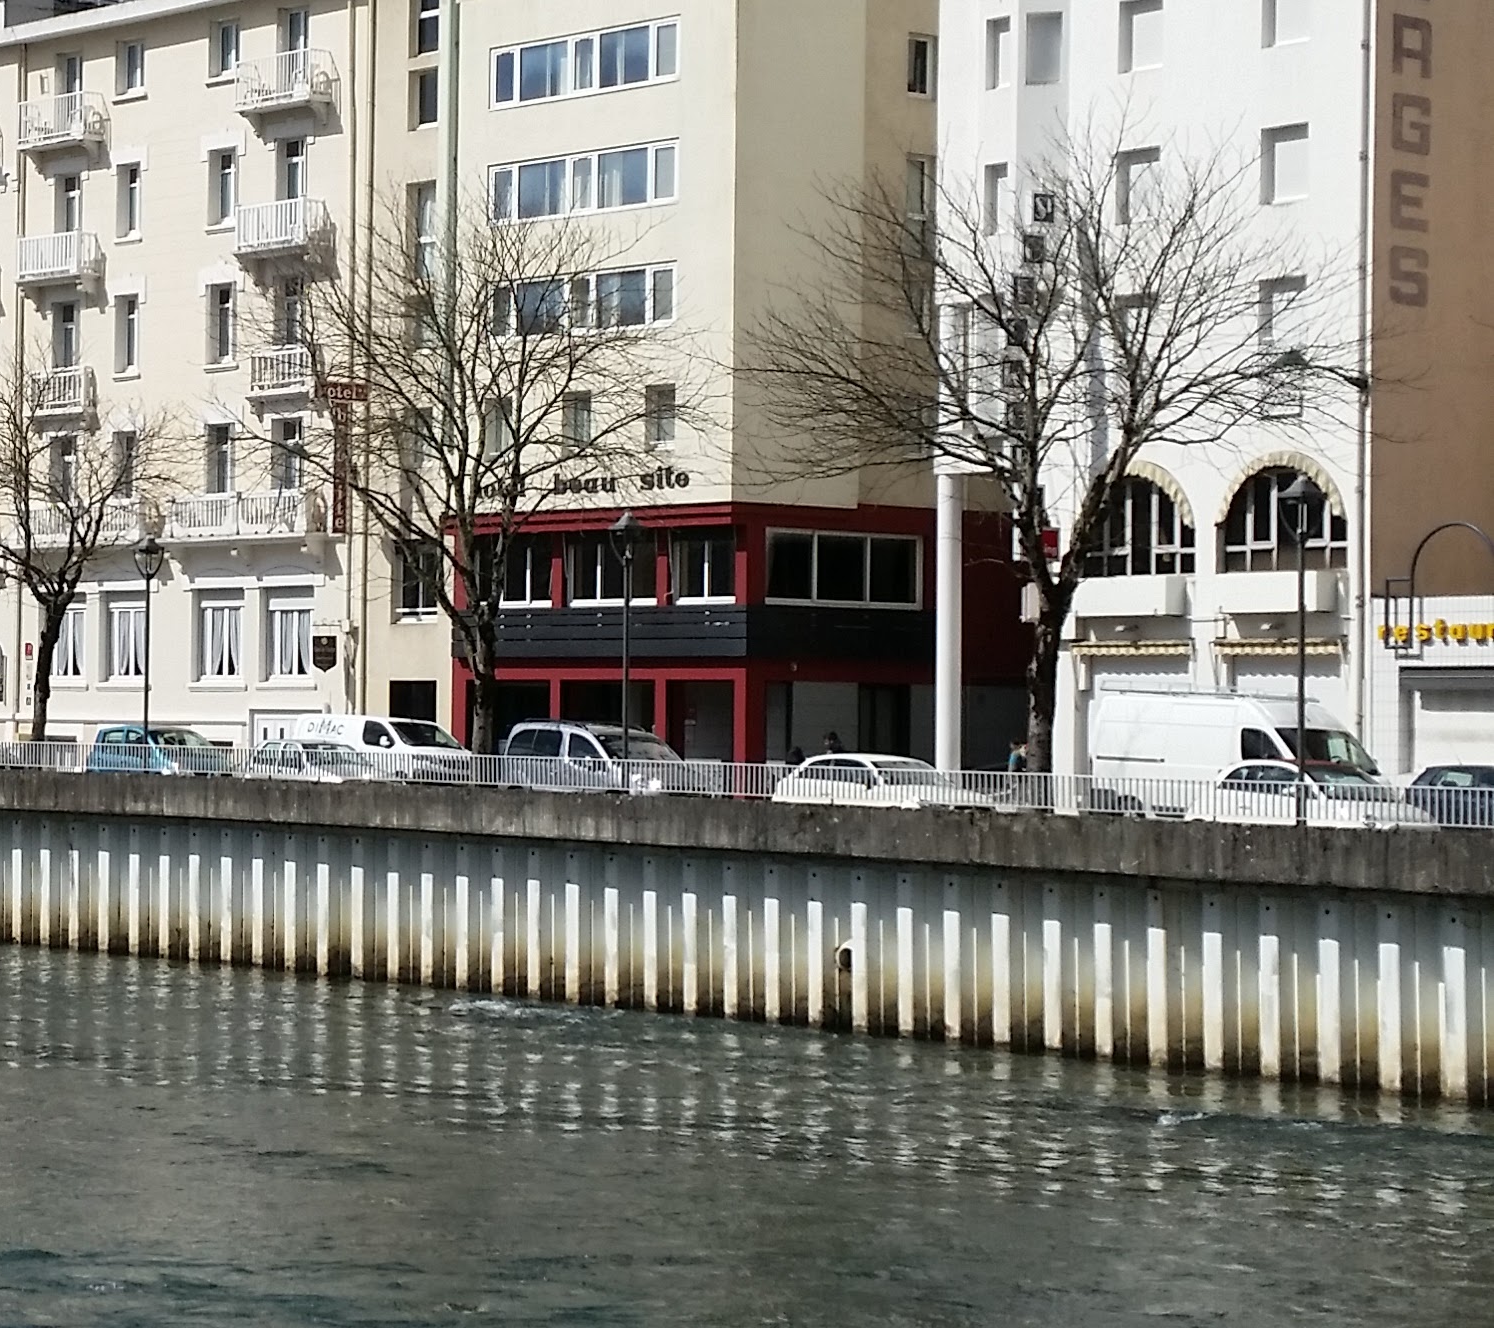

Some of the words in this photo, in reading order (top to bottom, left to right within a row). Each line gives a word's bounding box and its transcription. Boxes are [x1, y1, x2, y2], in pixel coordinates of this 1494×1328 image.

[316, 385, 357, 400] otel
[554, 473, 616, 495] beau
[640, 466, 689, 490] site
[308, 718, 345, 735] DIMAC
